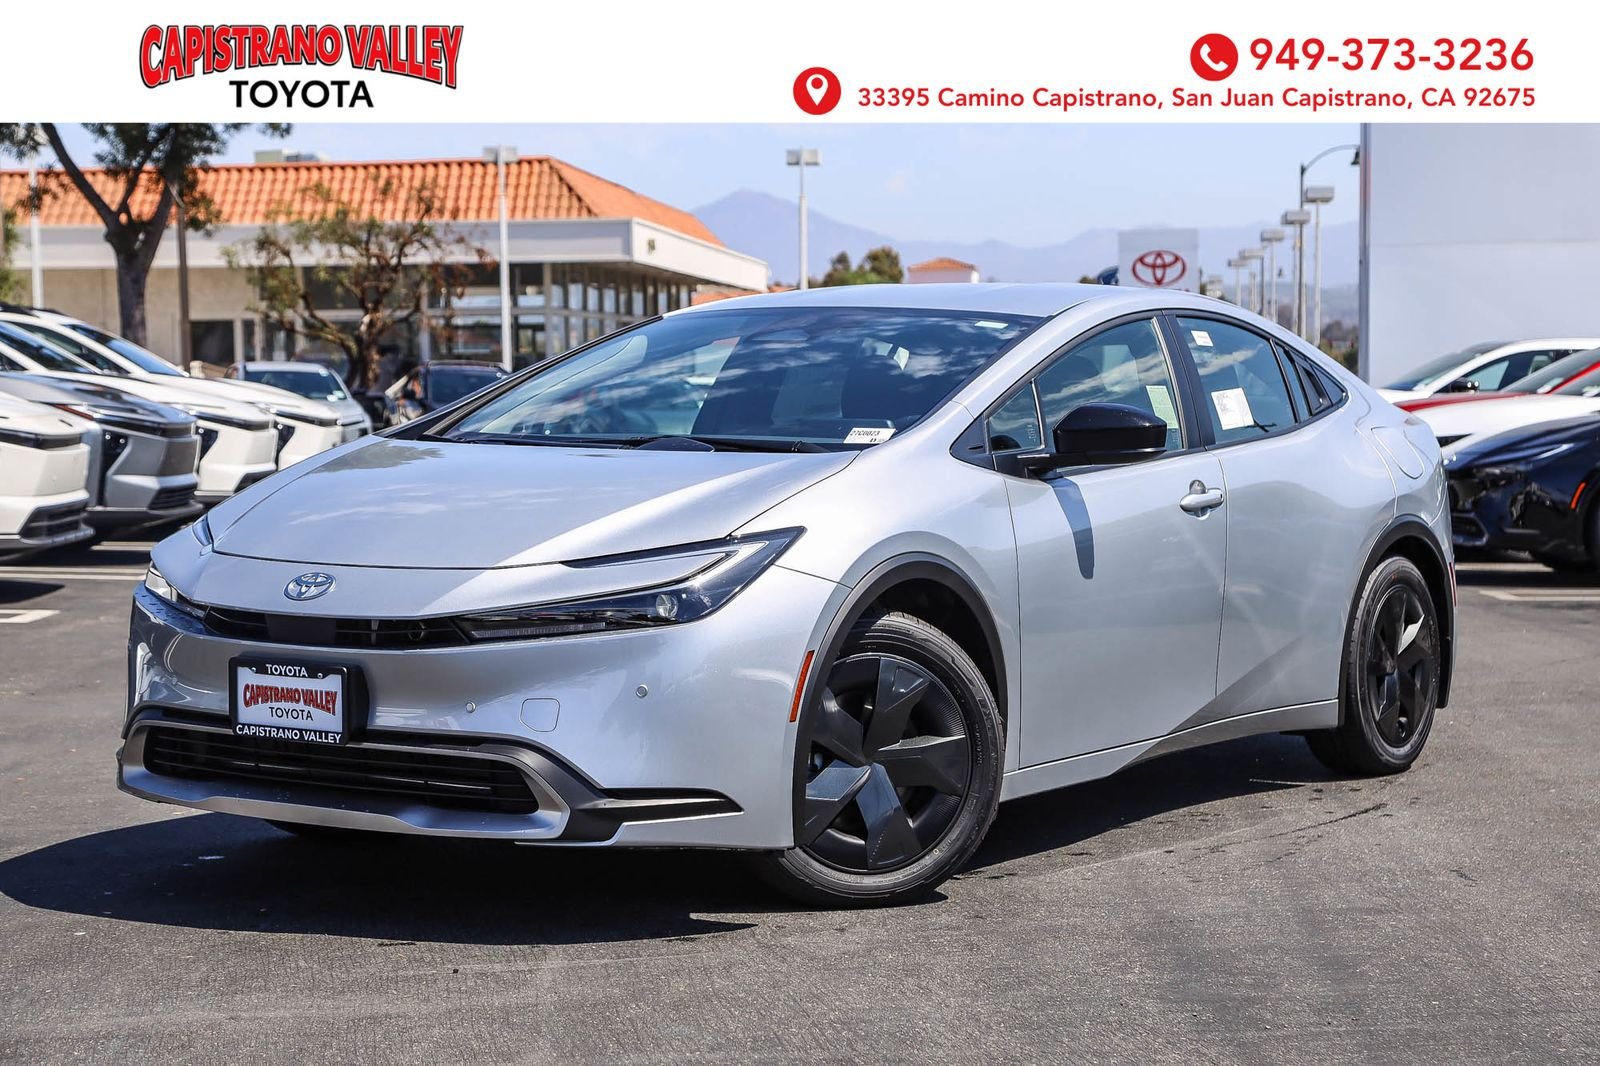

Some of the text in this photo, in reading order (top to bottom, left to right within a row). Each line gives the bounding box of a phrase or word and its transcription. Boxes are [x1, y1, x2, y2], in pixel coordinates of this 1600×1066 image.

[266, 664, 308, 677] TOYOTA
[243, 684, 337, 716] CAPISTRANO VALLEY
[269, 707, 313, 721] TOYOTA
[236, 725, 341, 744] CAPISTRANO VALLEY
